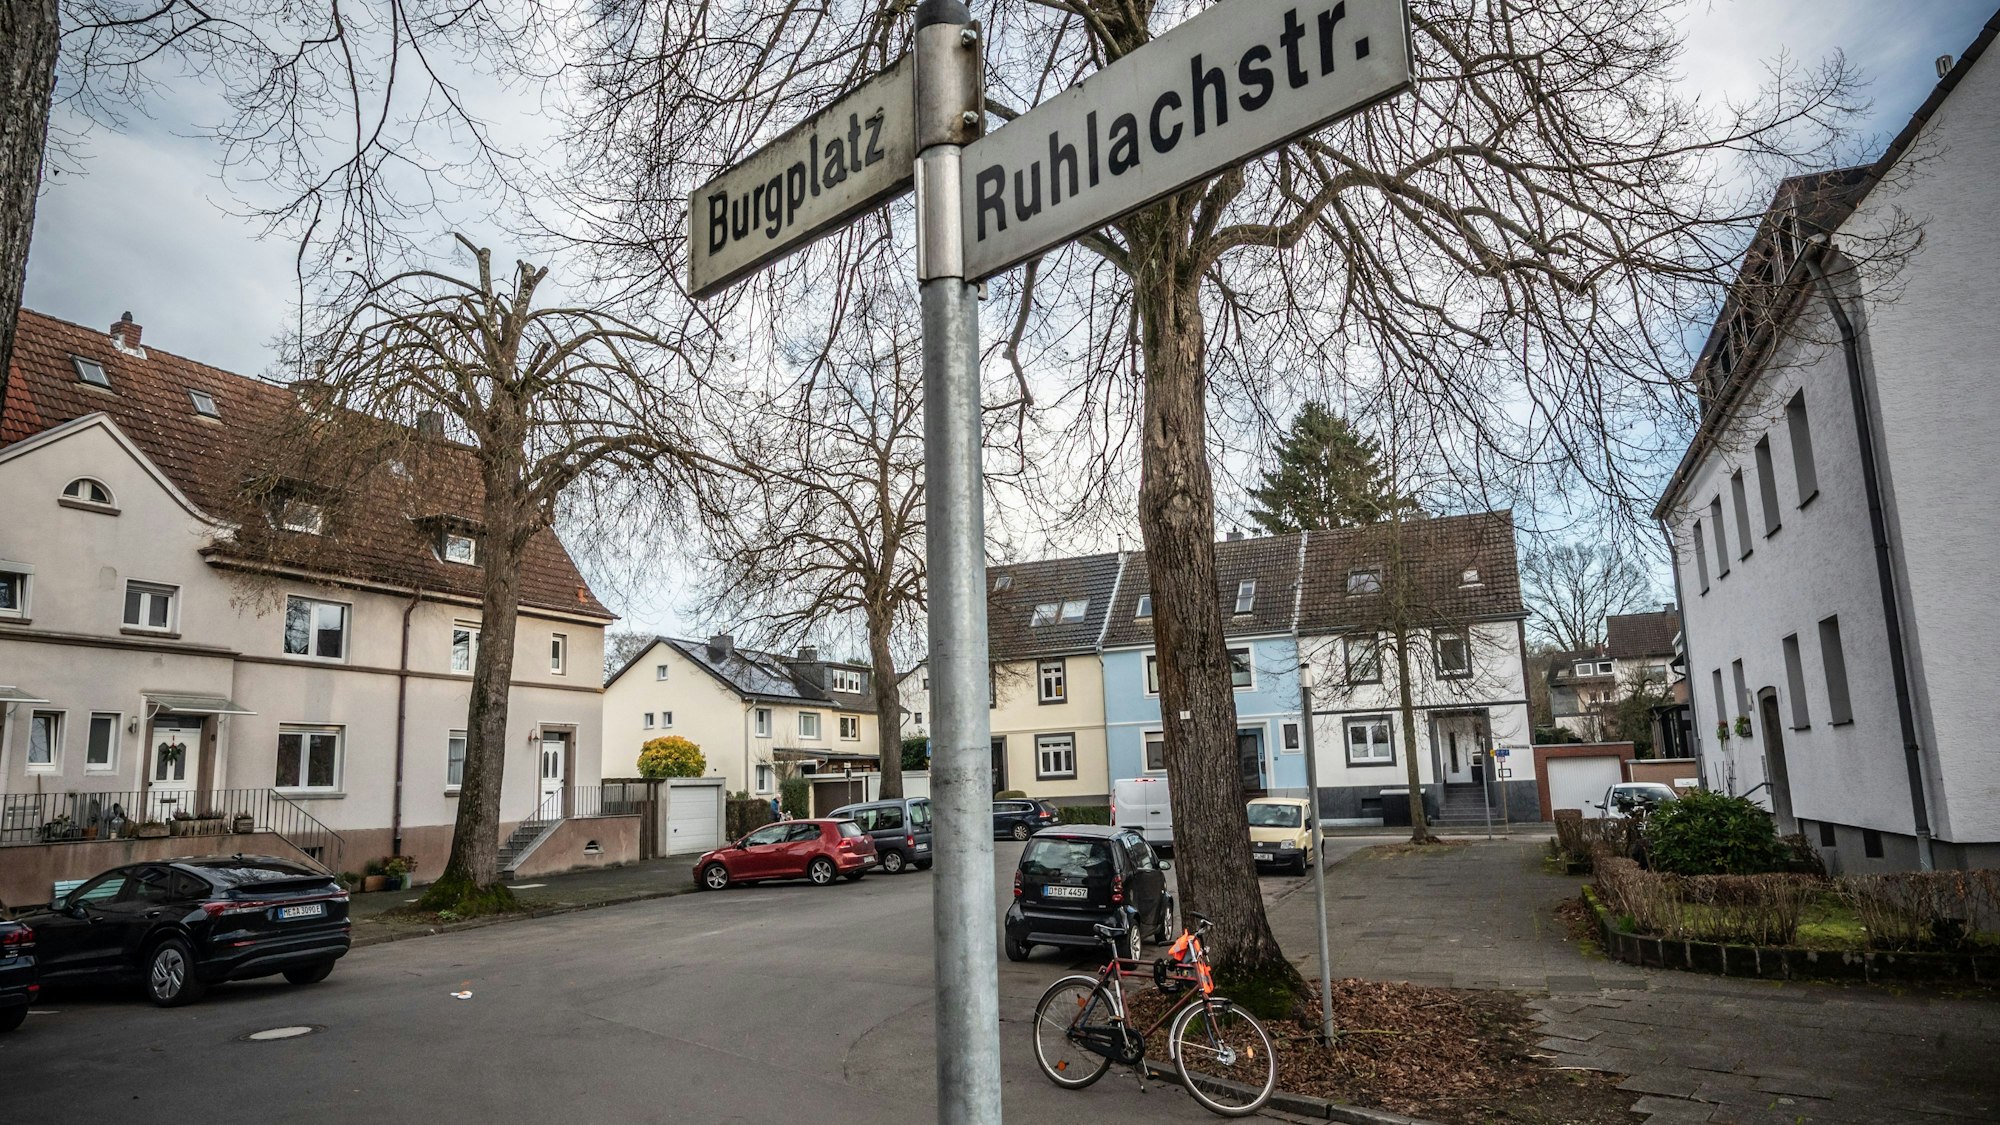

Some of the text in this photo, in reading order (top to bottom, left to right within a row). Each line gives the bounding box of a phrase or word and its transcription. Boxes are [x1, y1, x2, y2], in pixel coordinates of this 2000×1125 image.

[976, 0, 1369, 242] Ruhlachstr.
[708, 106, 885, 257] Burgplatz
[284, 908, 293, 917] ME
[1049, 887, 1087, 897] D BT 4457
